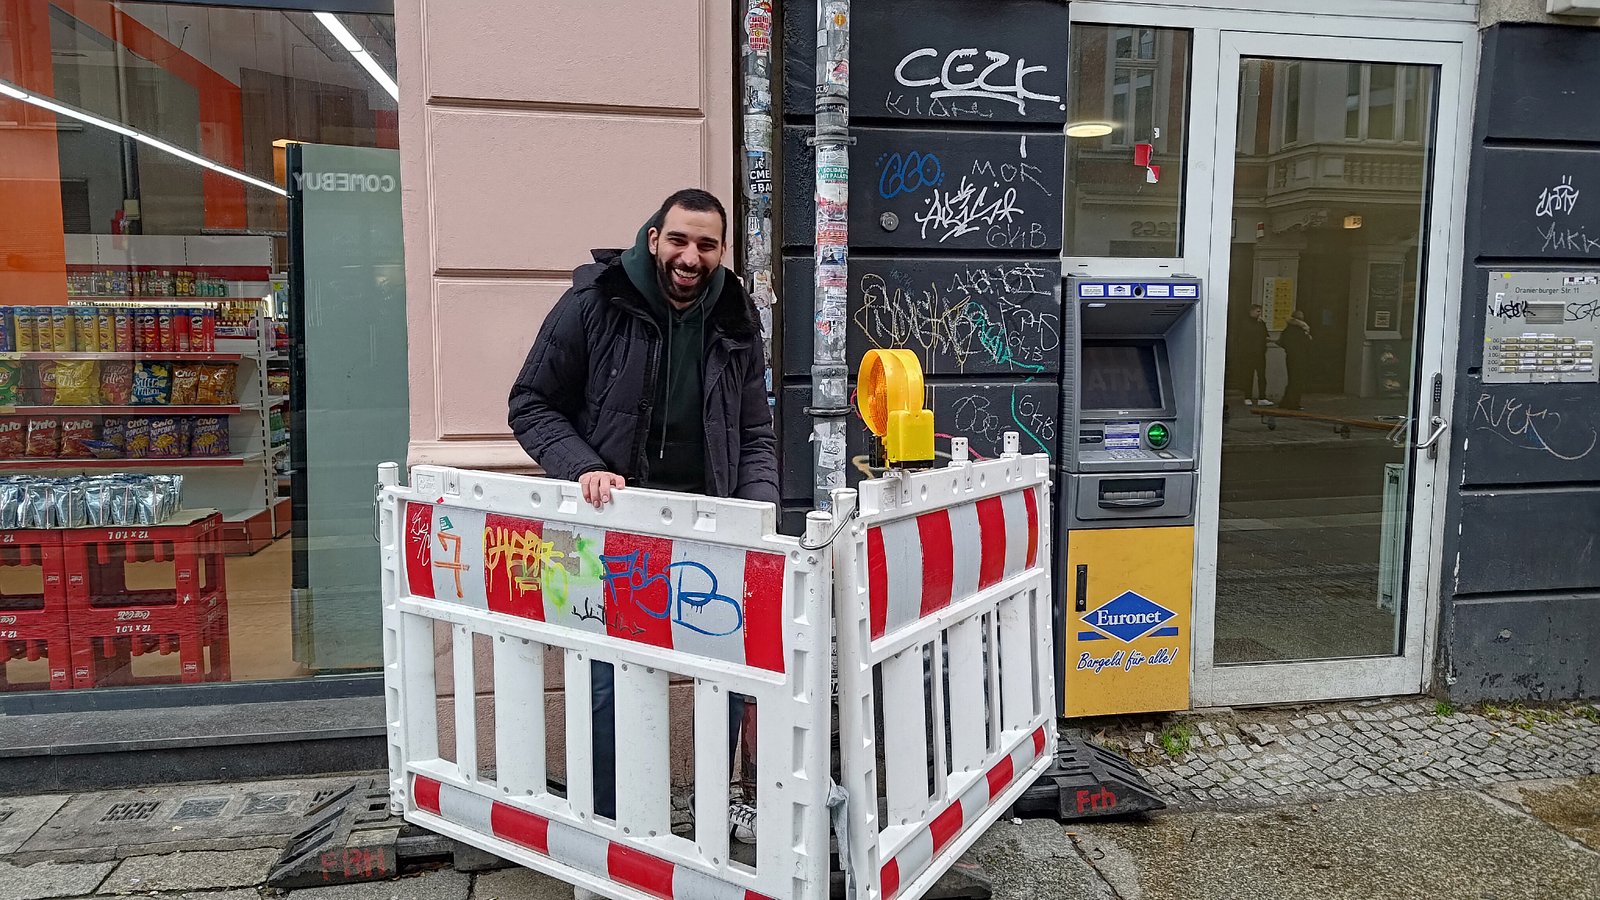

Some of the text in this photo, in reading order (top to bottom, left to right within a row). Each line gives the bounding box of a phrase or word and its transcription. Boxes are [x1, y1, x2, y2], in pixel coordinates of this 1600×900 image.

[0, 421, 21, 432] hio
[115, 531, 129, 539] 1.0
[138, 530, 149, 538] 12
[1096, 609, 1162, 626] Euronet
[121, 625, 134, 633] 1.0
[141, 624, 151, 632] 12
[1076, 647, 1179, 674] Bargeld für alle!
[1076, 786, 1117, 814] Frh
[321, 848, 386, 881] FRH
